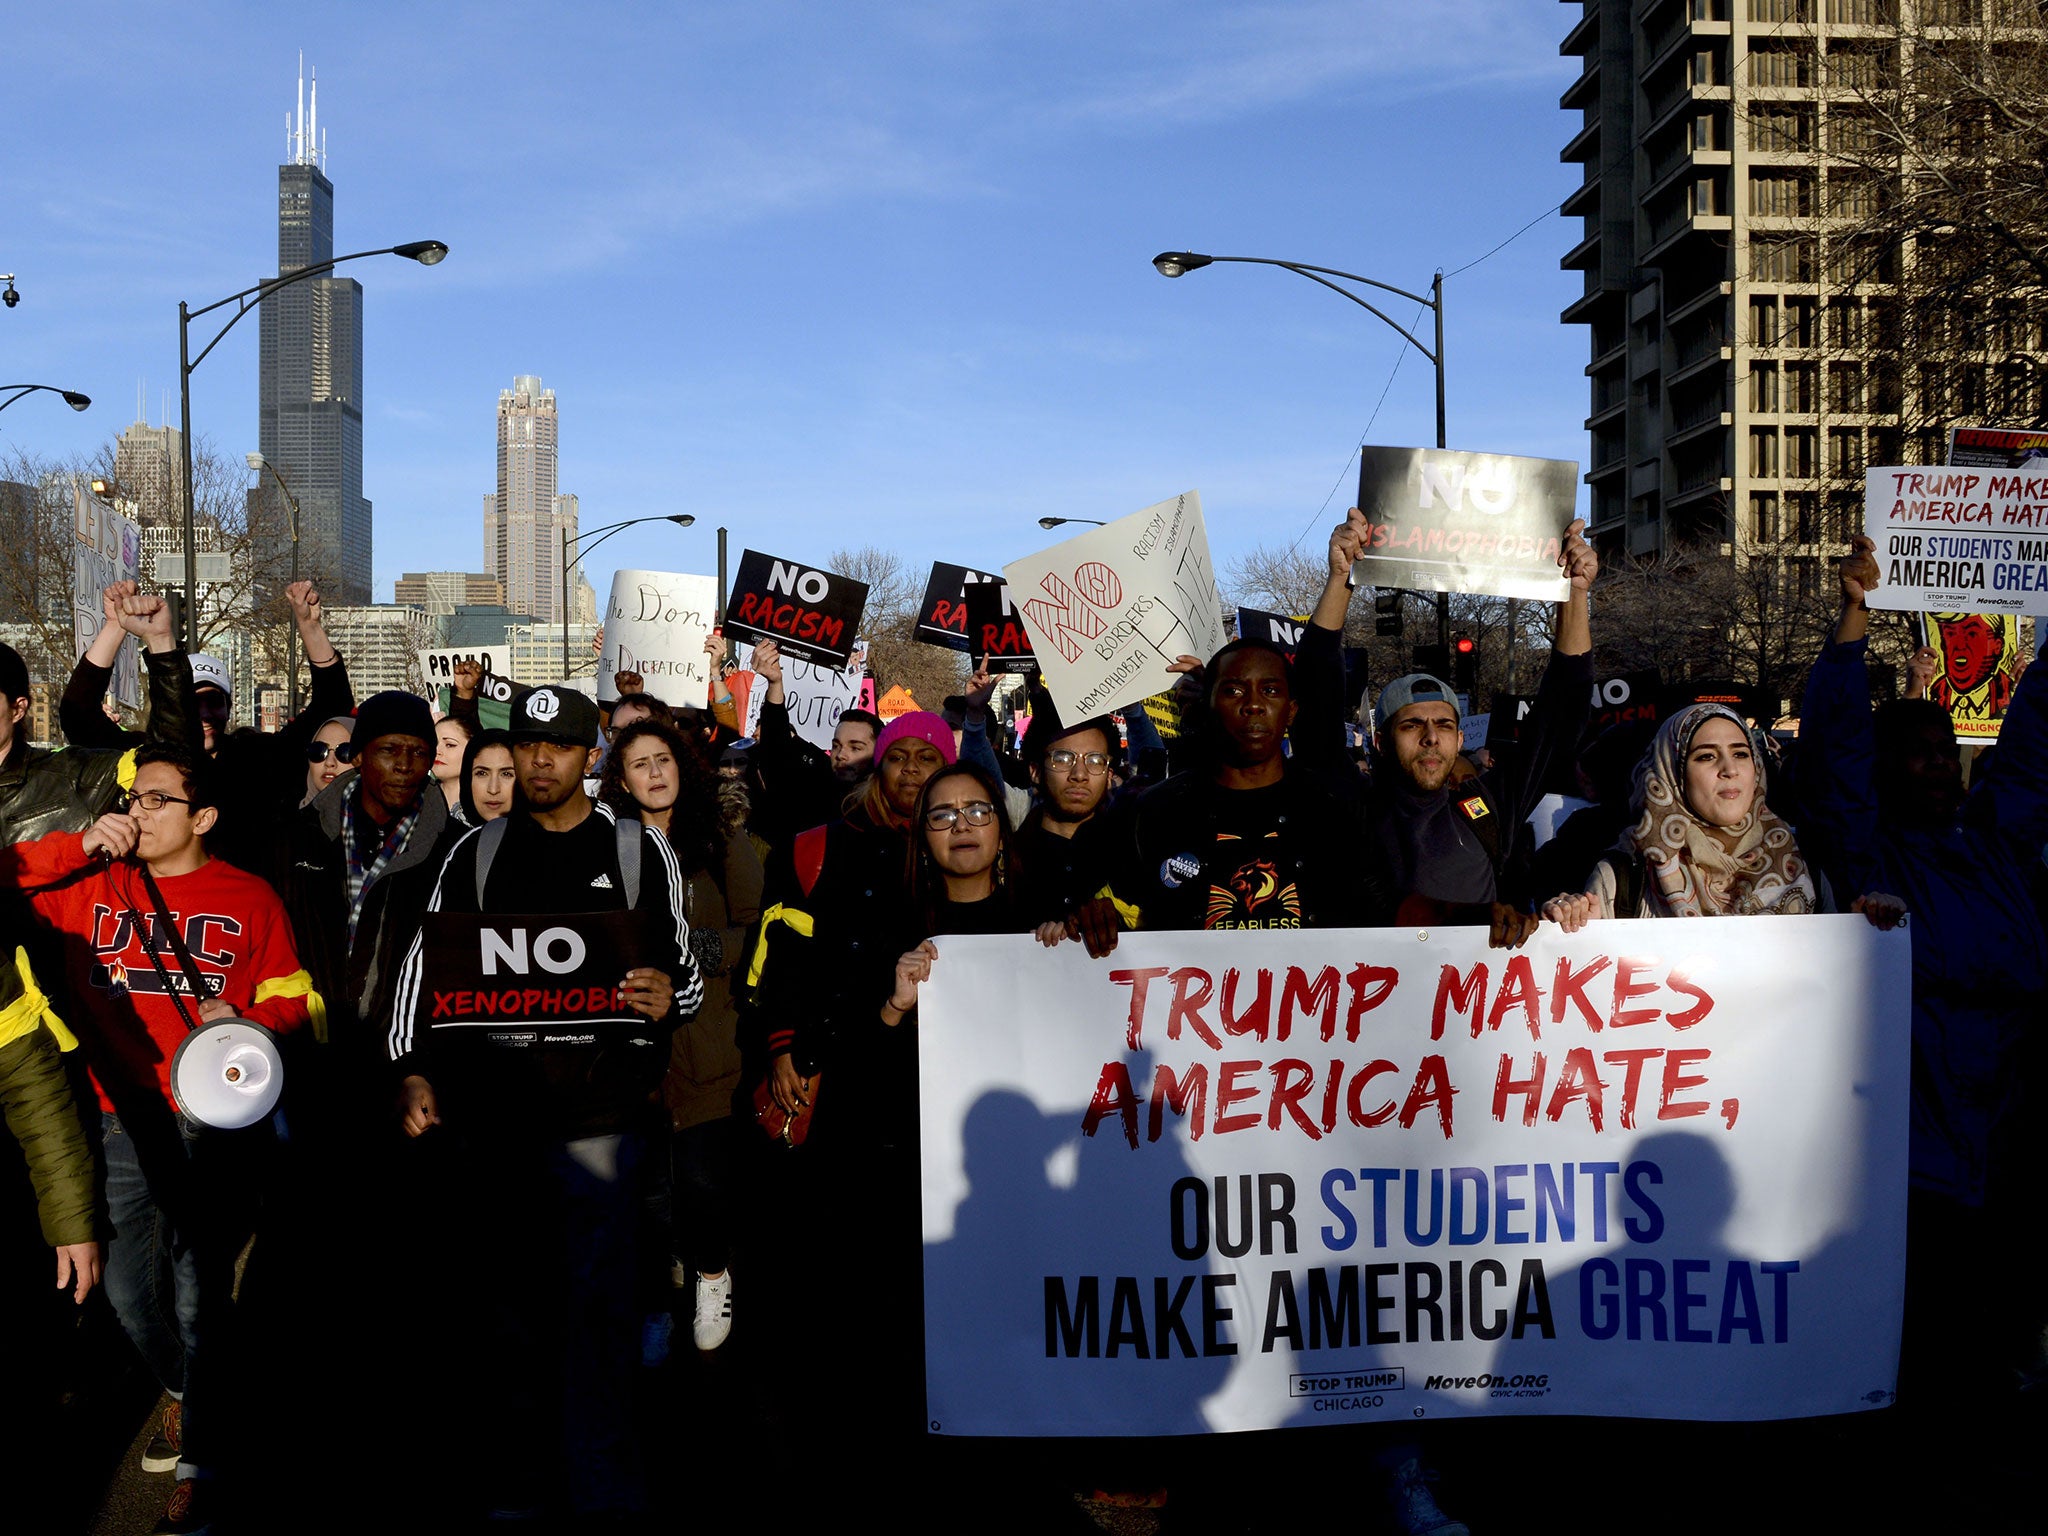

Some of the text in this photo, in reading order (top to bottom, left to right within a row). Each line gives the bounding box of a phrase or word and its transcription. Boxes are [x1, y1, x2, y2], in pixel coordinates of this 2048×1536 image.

[1419, 461, 1518, 515] NO
[1891, 473, 2048, 502] TRUMP MAKE
[1889, 499, 2048, 528] AMERICA HAT
[1132, 513, 1166, 561] RACISM
[1364, 523, 1561, 562] ISLAMOPHOBIA
[1889, 535, 1922, 557] OUR
[1927, 536, 2013, 560] STUDENTS
[766, 560, 829, 604] NO
[1887, 559, 2048, 592] AMERICA GREA
[1022, 562, 1123, 664] NO
[1976, 598, 2024, 606] MoveOn.ORG
[738, 592, 845, 648] RACISM
[1094, 595, 1154, 662] BORDERS
[194, 663, 222, 676] GOLF
[1075, 649, 1149, 716] HOMOPHOBIA
[482, 675, 512, 701] NO
[887, 698, 906, 706] ROAD
[1172, 867, 1194, 878] MATTER
[1176, 856, 1197, 868] BLACK
[590, 881, 613, 889] adidas
[1215, 917, 1301, 931] FEARLESS
[480, 926, 587, 975] NO
[1108, 953, 1717, 1052] TRUMP MAKES
[543, 1034, 595, 1043] MoveOn.ORG
[1080, 1046, 1740, 1151] AMERICA HATE,
[1169, 1160, 1665, 1261] OUR STUDENTS
[1043, 1257, 1800, 1360] MAKE AMERICA GREAT
[1298, 1373, 1398, 1392] STOP TRUMP
[1424, 1373, 1549, 1390] MoveOn.ORG
[1490, 1389, 1544, 1398] CIVIC ACTION
[1313, 1395, 1384, 1412] CHICAGO
